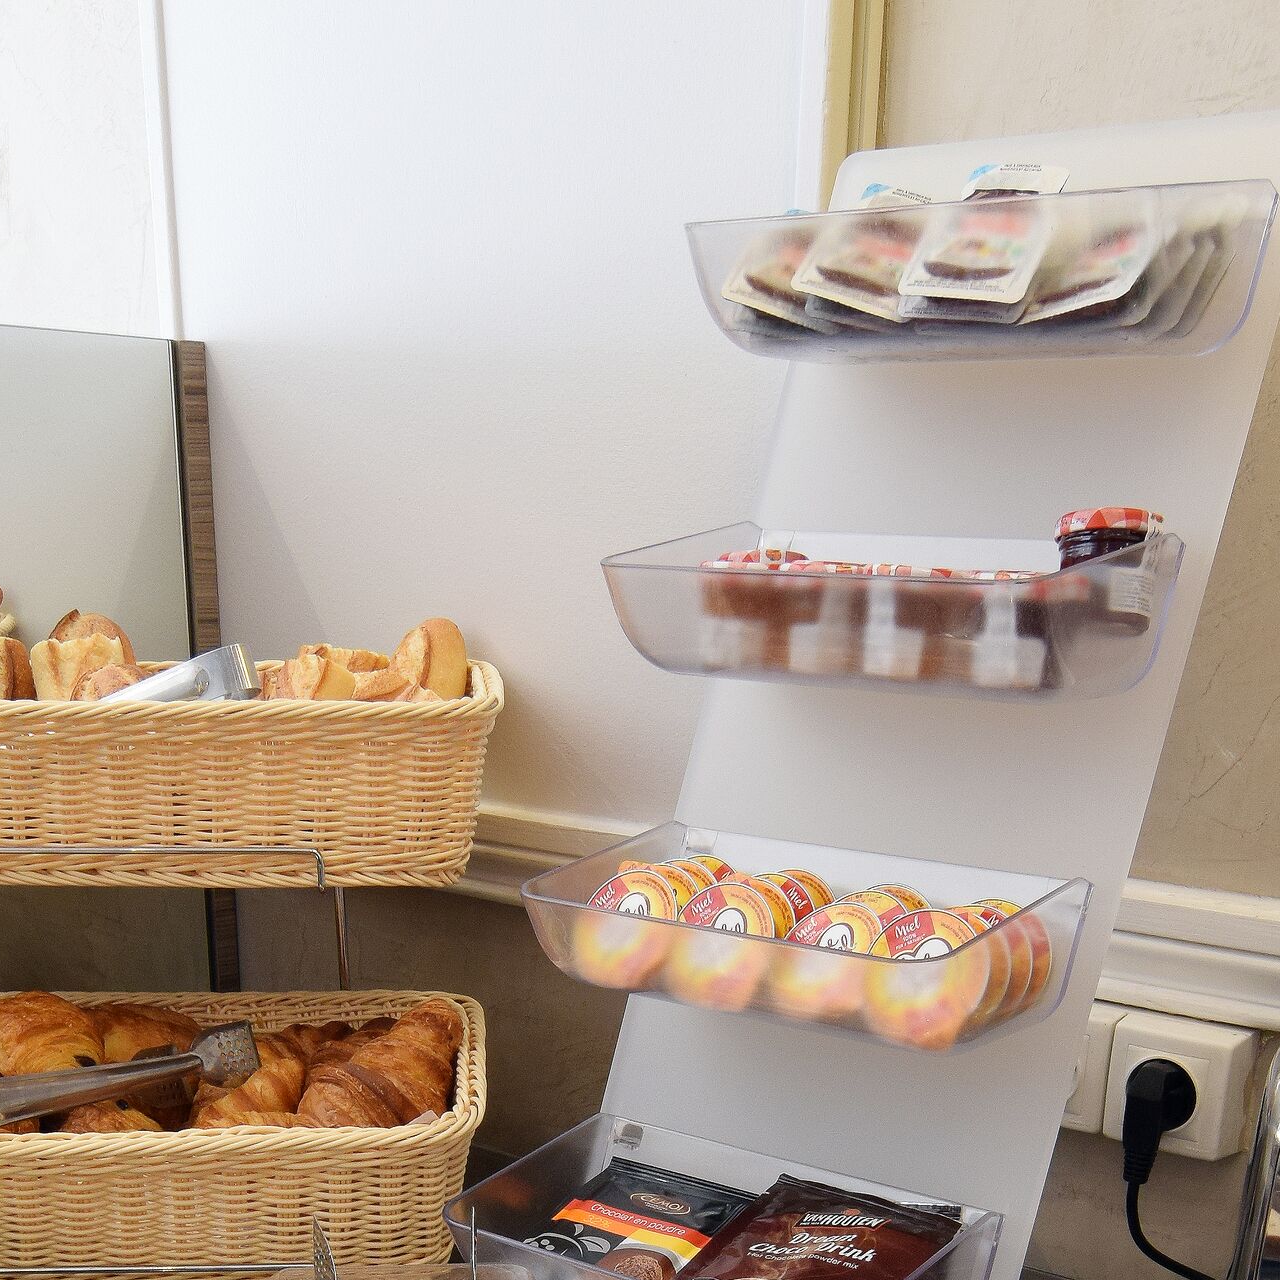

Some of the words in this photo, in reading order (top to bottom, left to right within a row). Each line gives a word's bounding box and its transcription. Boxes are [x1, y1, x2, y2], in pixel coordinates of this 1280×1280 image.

[595, 884, 616, 908] Miel
[691, 892, 714, 917] Miel
[787, 886, 808, 910] Miel
[795, 916, 818, 942] Miel
[894, 915, 921, 939] Miel
[591, 1203, 634, 1222] Chocolat
[633, 1217, 647, 1226] en
[646, 1221, 686, 1236] poudre
[788, 1232, 857, 1245] Dream
[748, 1242, 809, 1255] Choco
[814, 1241, 877, 1263] Drink
[807, 1253, 842, 1266] powder
[842, 1261, 860, 1270] mix
